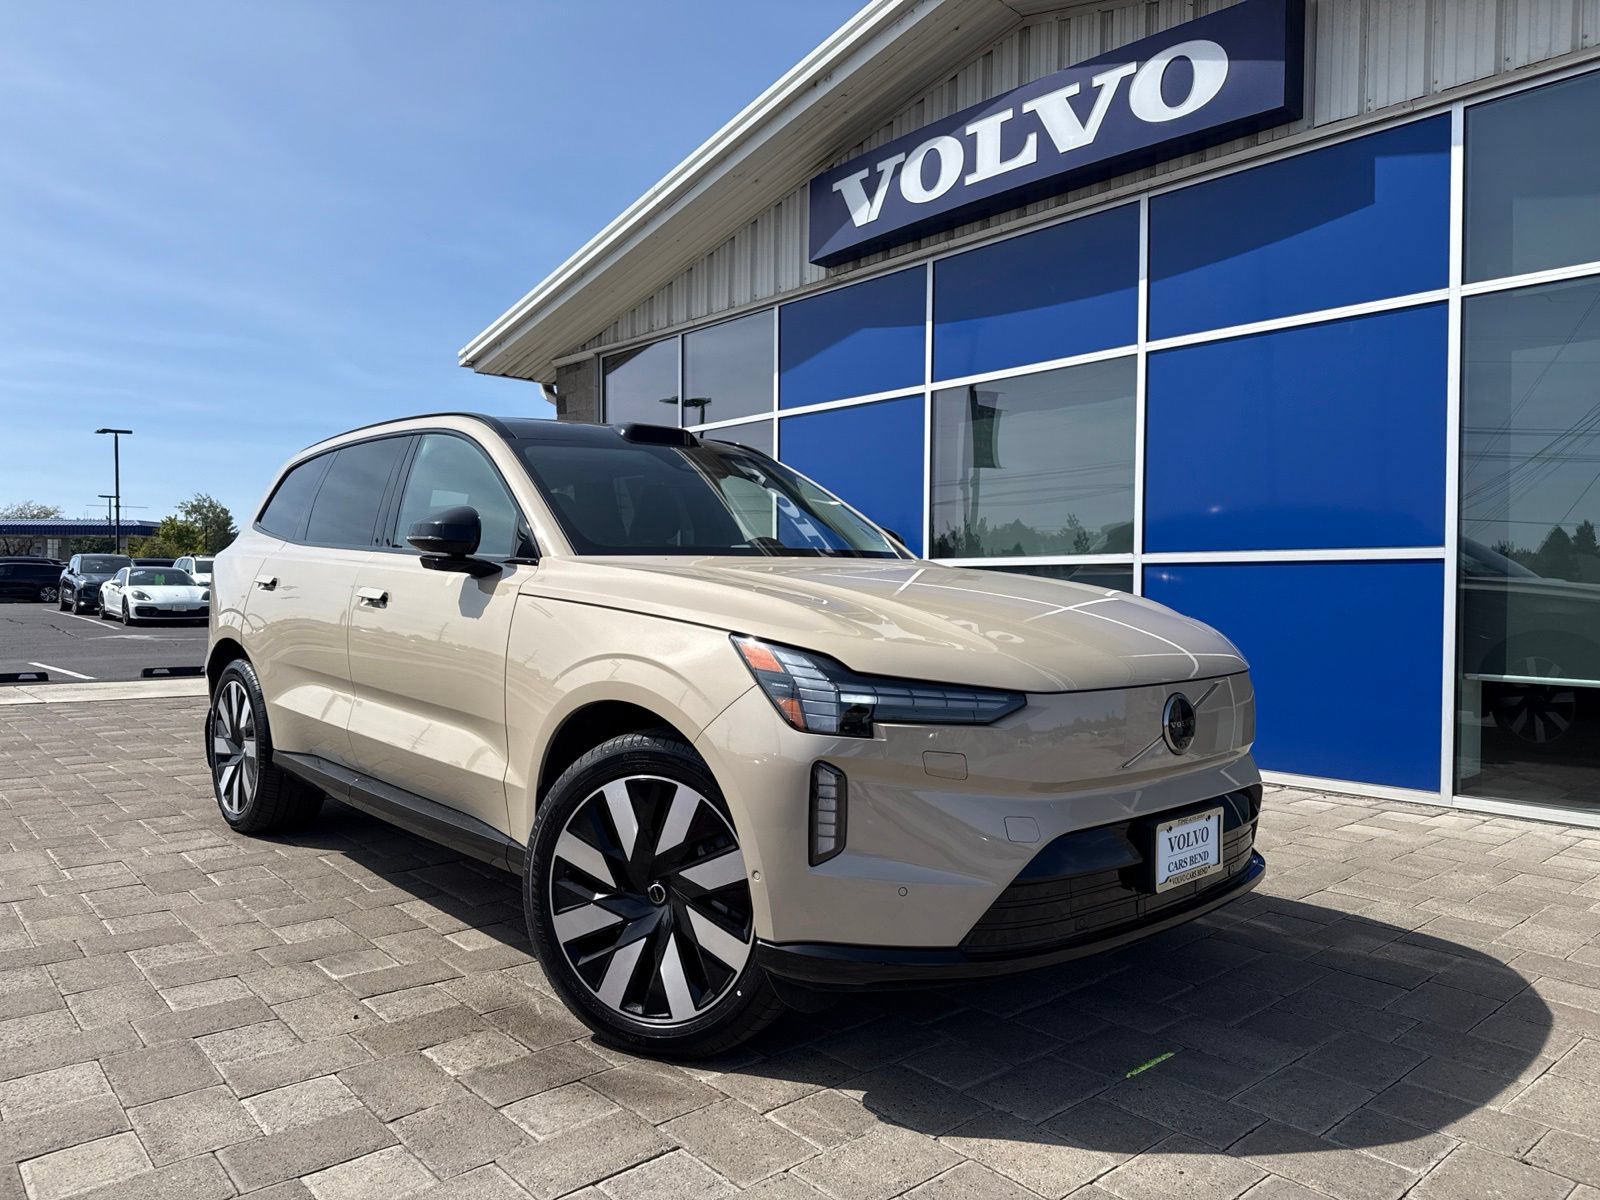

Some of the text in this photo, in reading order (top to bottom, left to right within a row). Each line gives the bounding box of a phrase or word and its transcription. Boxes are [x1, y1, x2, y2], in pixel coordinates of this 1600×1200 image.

[832, 39, 1229, 228] VOLVO
[1168, 826, 1209, 852] VOLVO
[1168, 851, 1209, 873] CARS BEND
